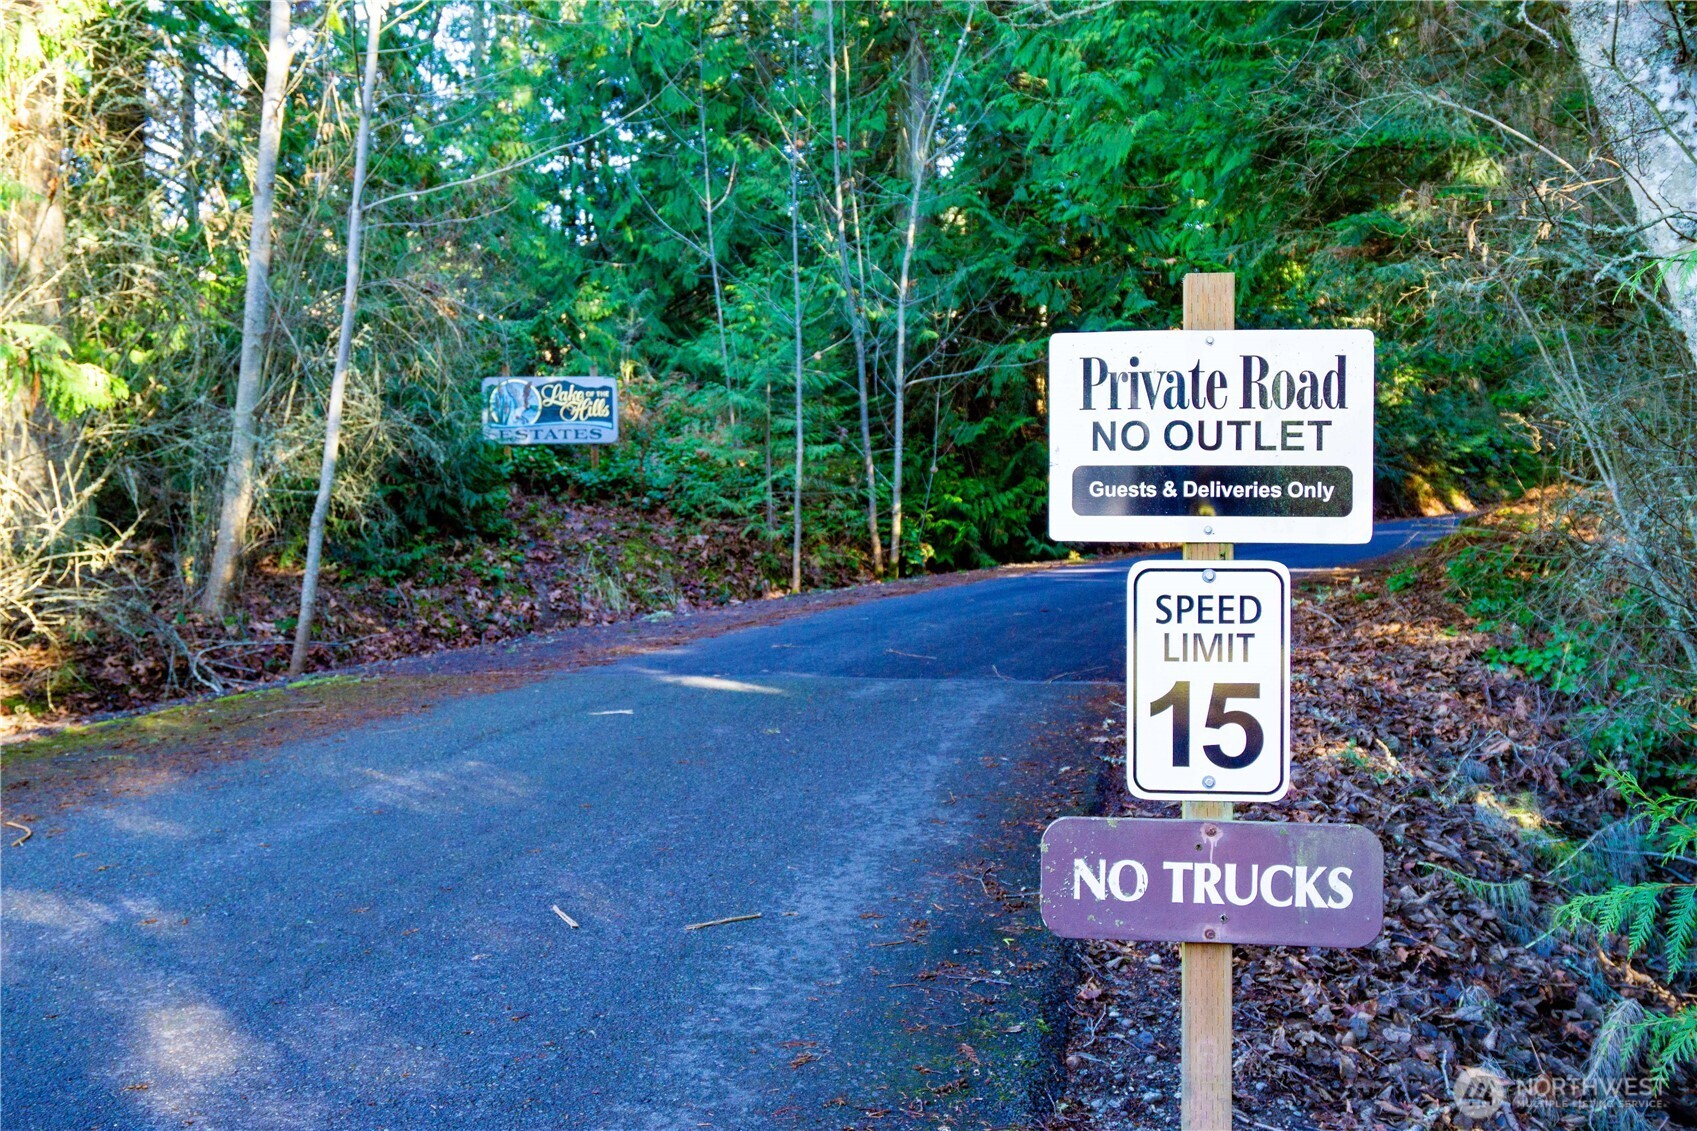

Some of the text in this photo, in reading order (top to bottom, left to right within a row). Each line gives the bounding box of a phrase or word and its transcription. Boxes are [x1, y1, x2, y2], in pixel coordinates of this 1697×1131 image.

[541, 383, 584, 407] Lake
[1079, 354, 1349, 411] Private Road
[560, 399, 610, 422] Hills
[500, 428, 603, 440] ESTATES
[1092, 420, 1333, 452] NO OUTLET
[1089, 480, 1335, 502] Guests & Deliveries Only
[1155, 594, 1262, 625] SPEED
[1163, 632, 1255, 663] LIMIT
[1149, 680, 1264, 770] 15
[1073, 857, 1354, 910] NO TRUCKS
